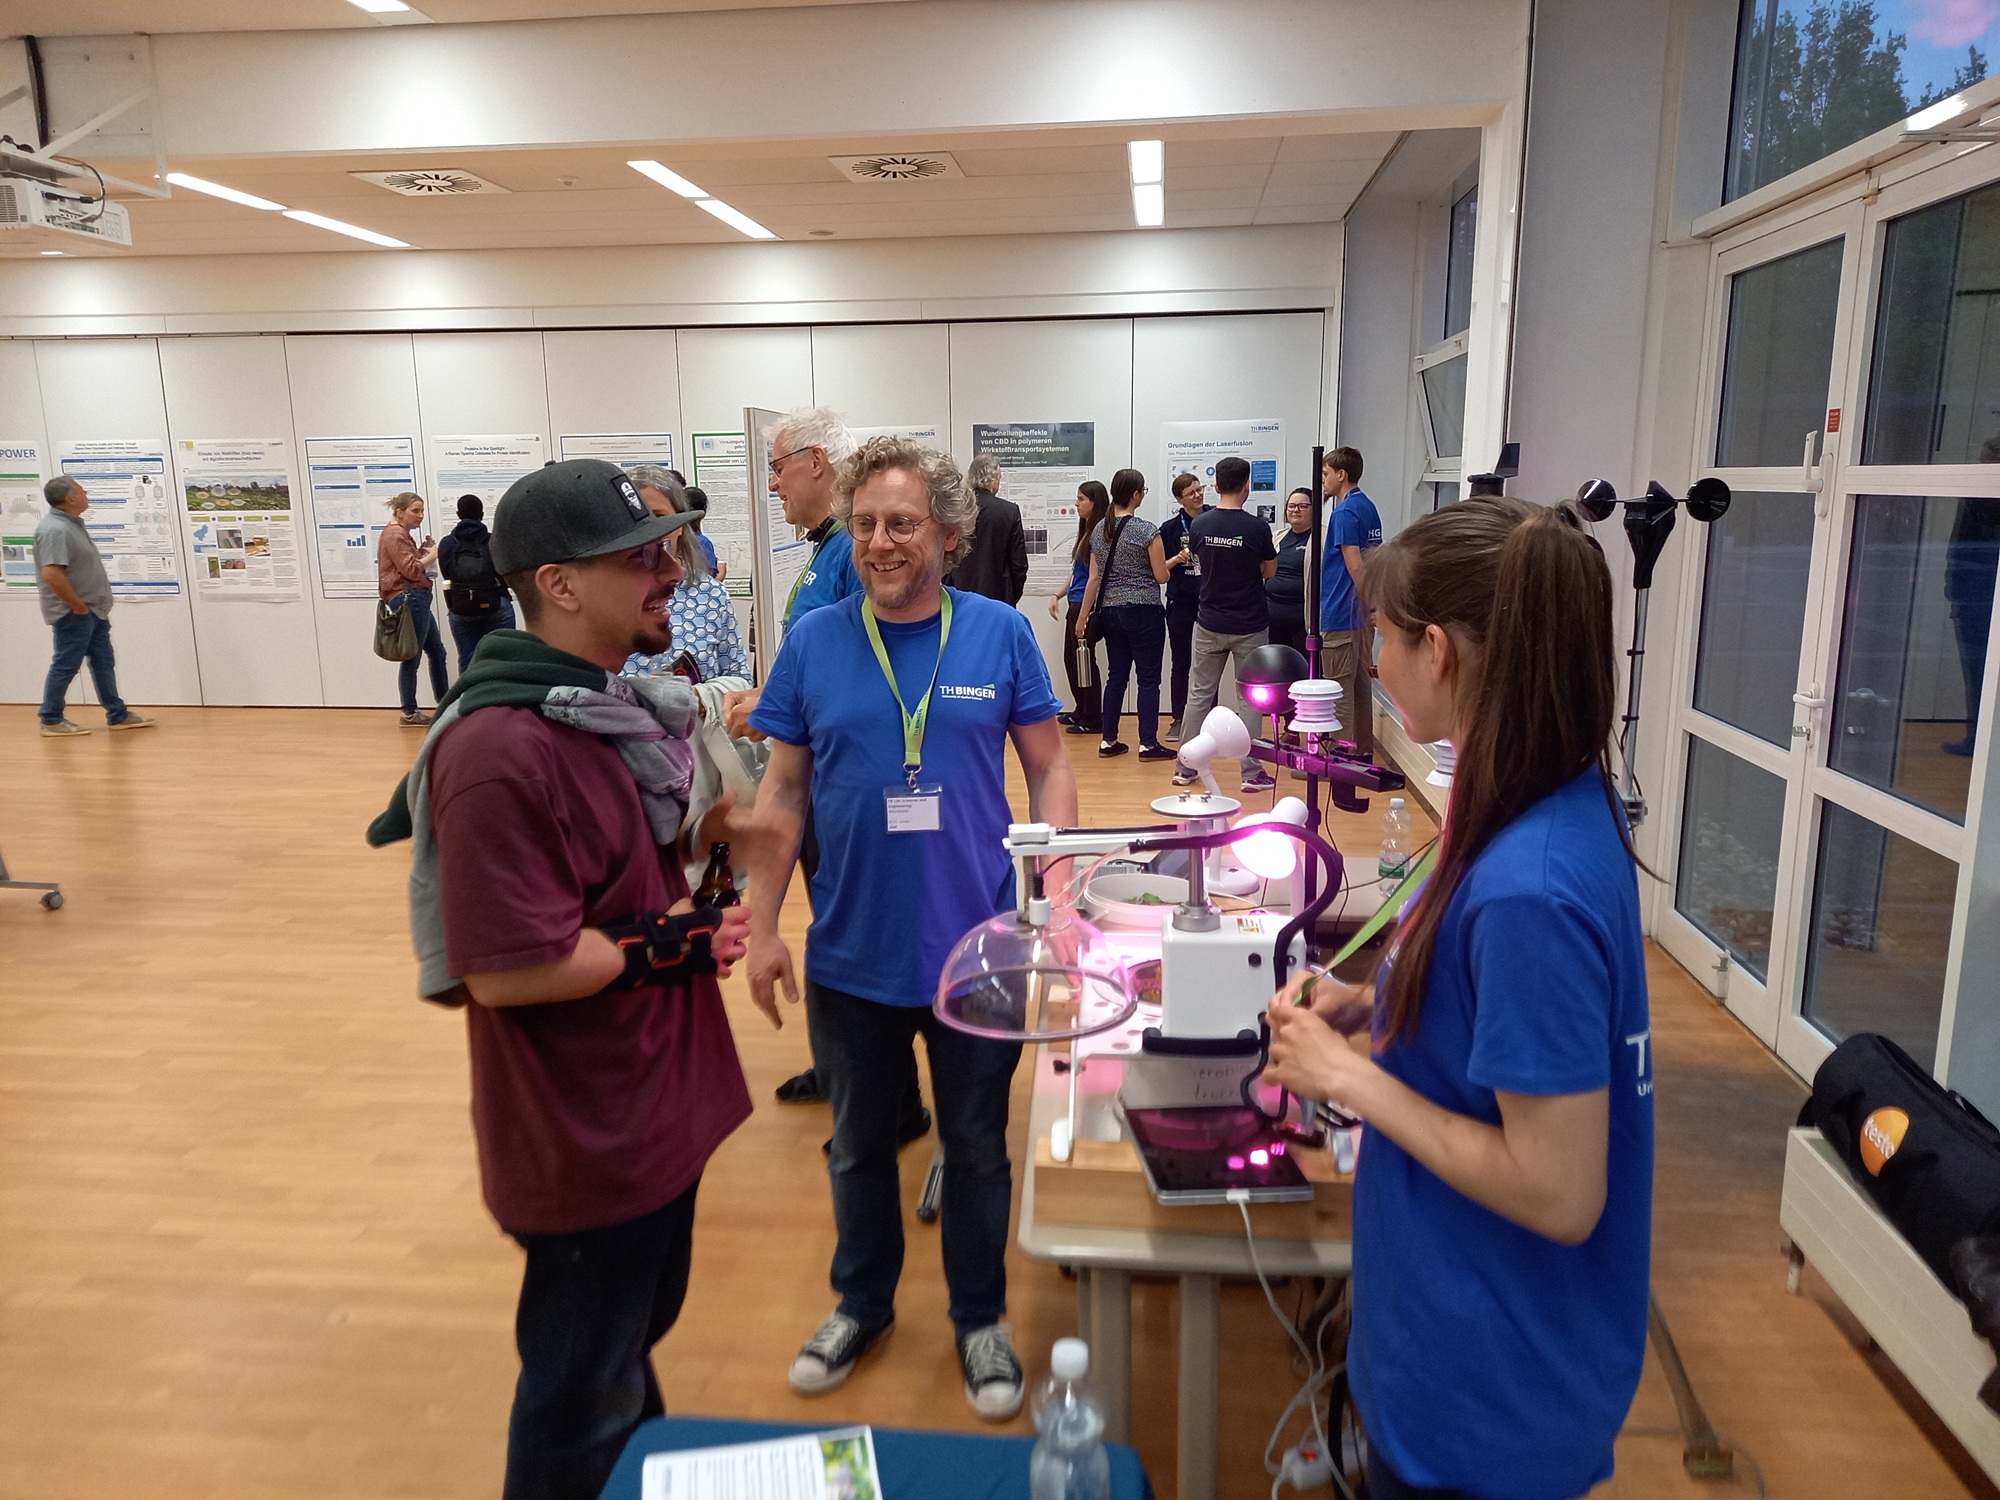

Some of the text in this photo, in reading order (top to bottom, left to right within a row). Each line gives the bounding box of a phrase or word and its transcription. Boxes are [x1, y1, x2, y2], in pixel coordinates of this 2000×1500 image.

[980, 429, 1048, 437] Wundheilungseffekte
[1018, 438, 1053, 447] polymeren
[1216, 439, 1253, 447] Laserfusion
[0, 449, 36, 458] POWER
[980, 446, 1070, 454] Wirkstofftransportsystemen
[1204, 535, 1213, 544] TH
[1213, 536, 1243, 547] BINGEN
[939, 685, 995, 699] TH BINGEN
[1864, 1115, 1895, 1160] testo
